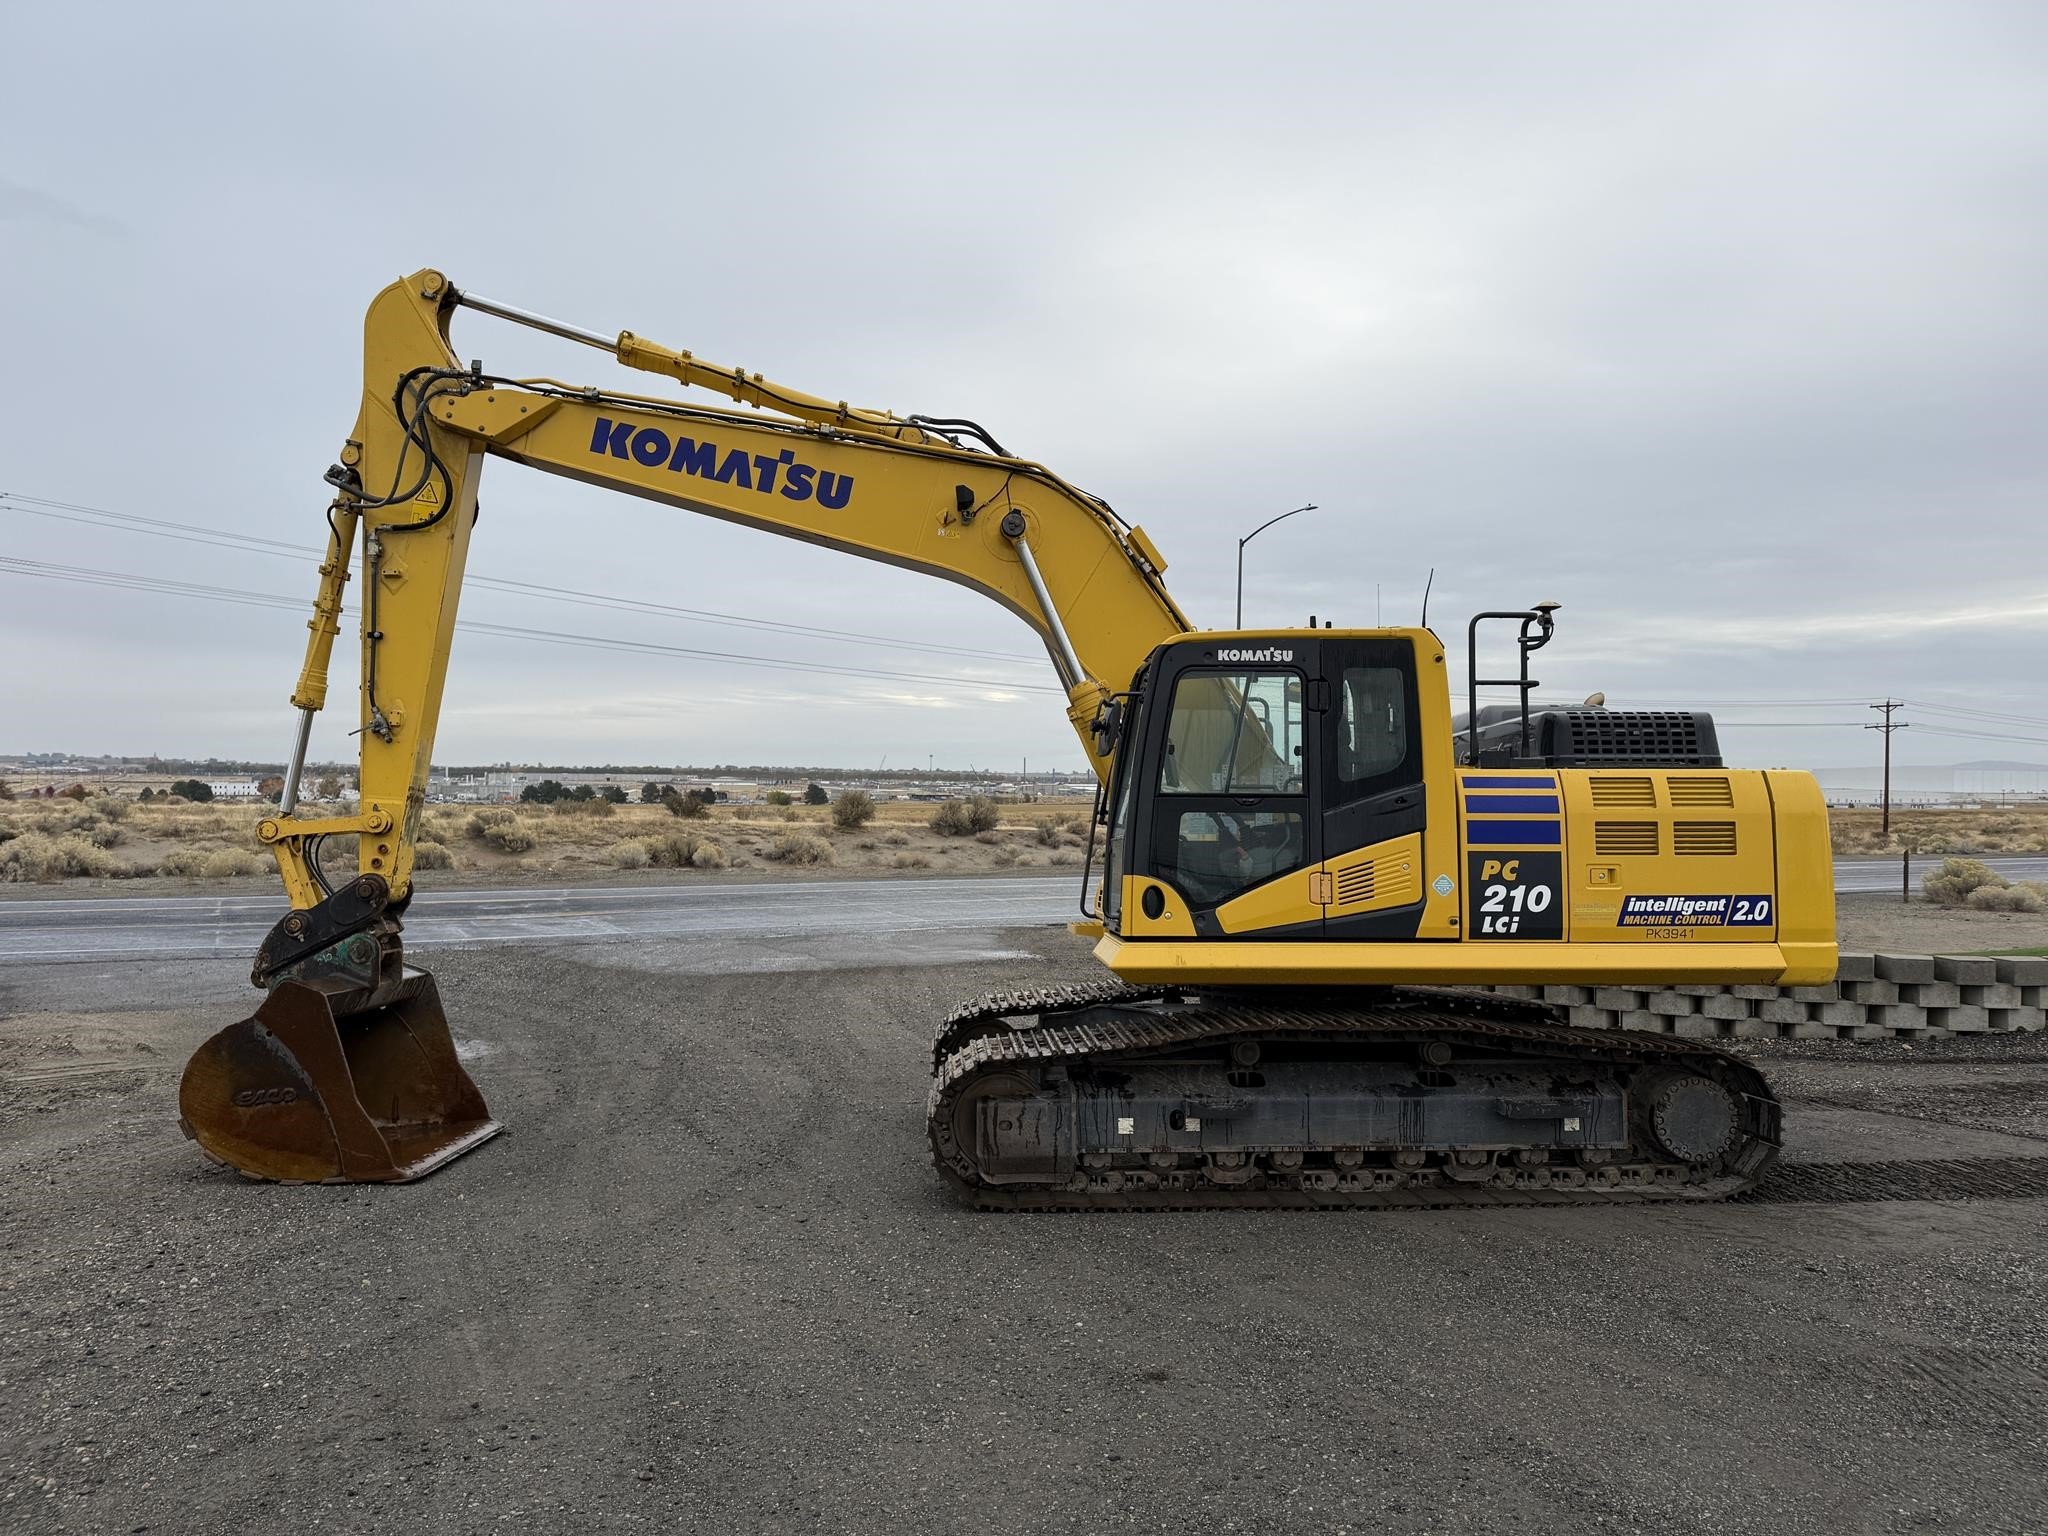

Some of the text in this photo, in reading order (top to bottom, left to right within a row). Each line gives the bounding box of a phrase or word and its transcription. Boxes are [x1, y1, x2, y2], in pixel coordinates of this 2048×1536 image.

[589, 416, 854, 510] KOMATSU
[1217, 646, 1293, 662] KOMATSU
[1480, 859, 1520, 881] PC
[1479, 884, 1552, 913] 210
[1623, 915, 1722, 925] MACHINE CONTROL
[1732, 900, 1769, 921] 2.0
[1481, 915, 1520, 934] LCi
[1645, 929, 1695, 939] PK3941
